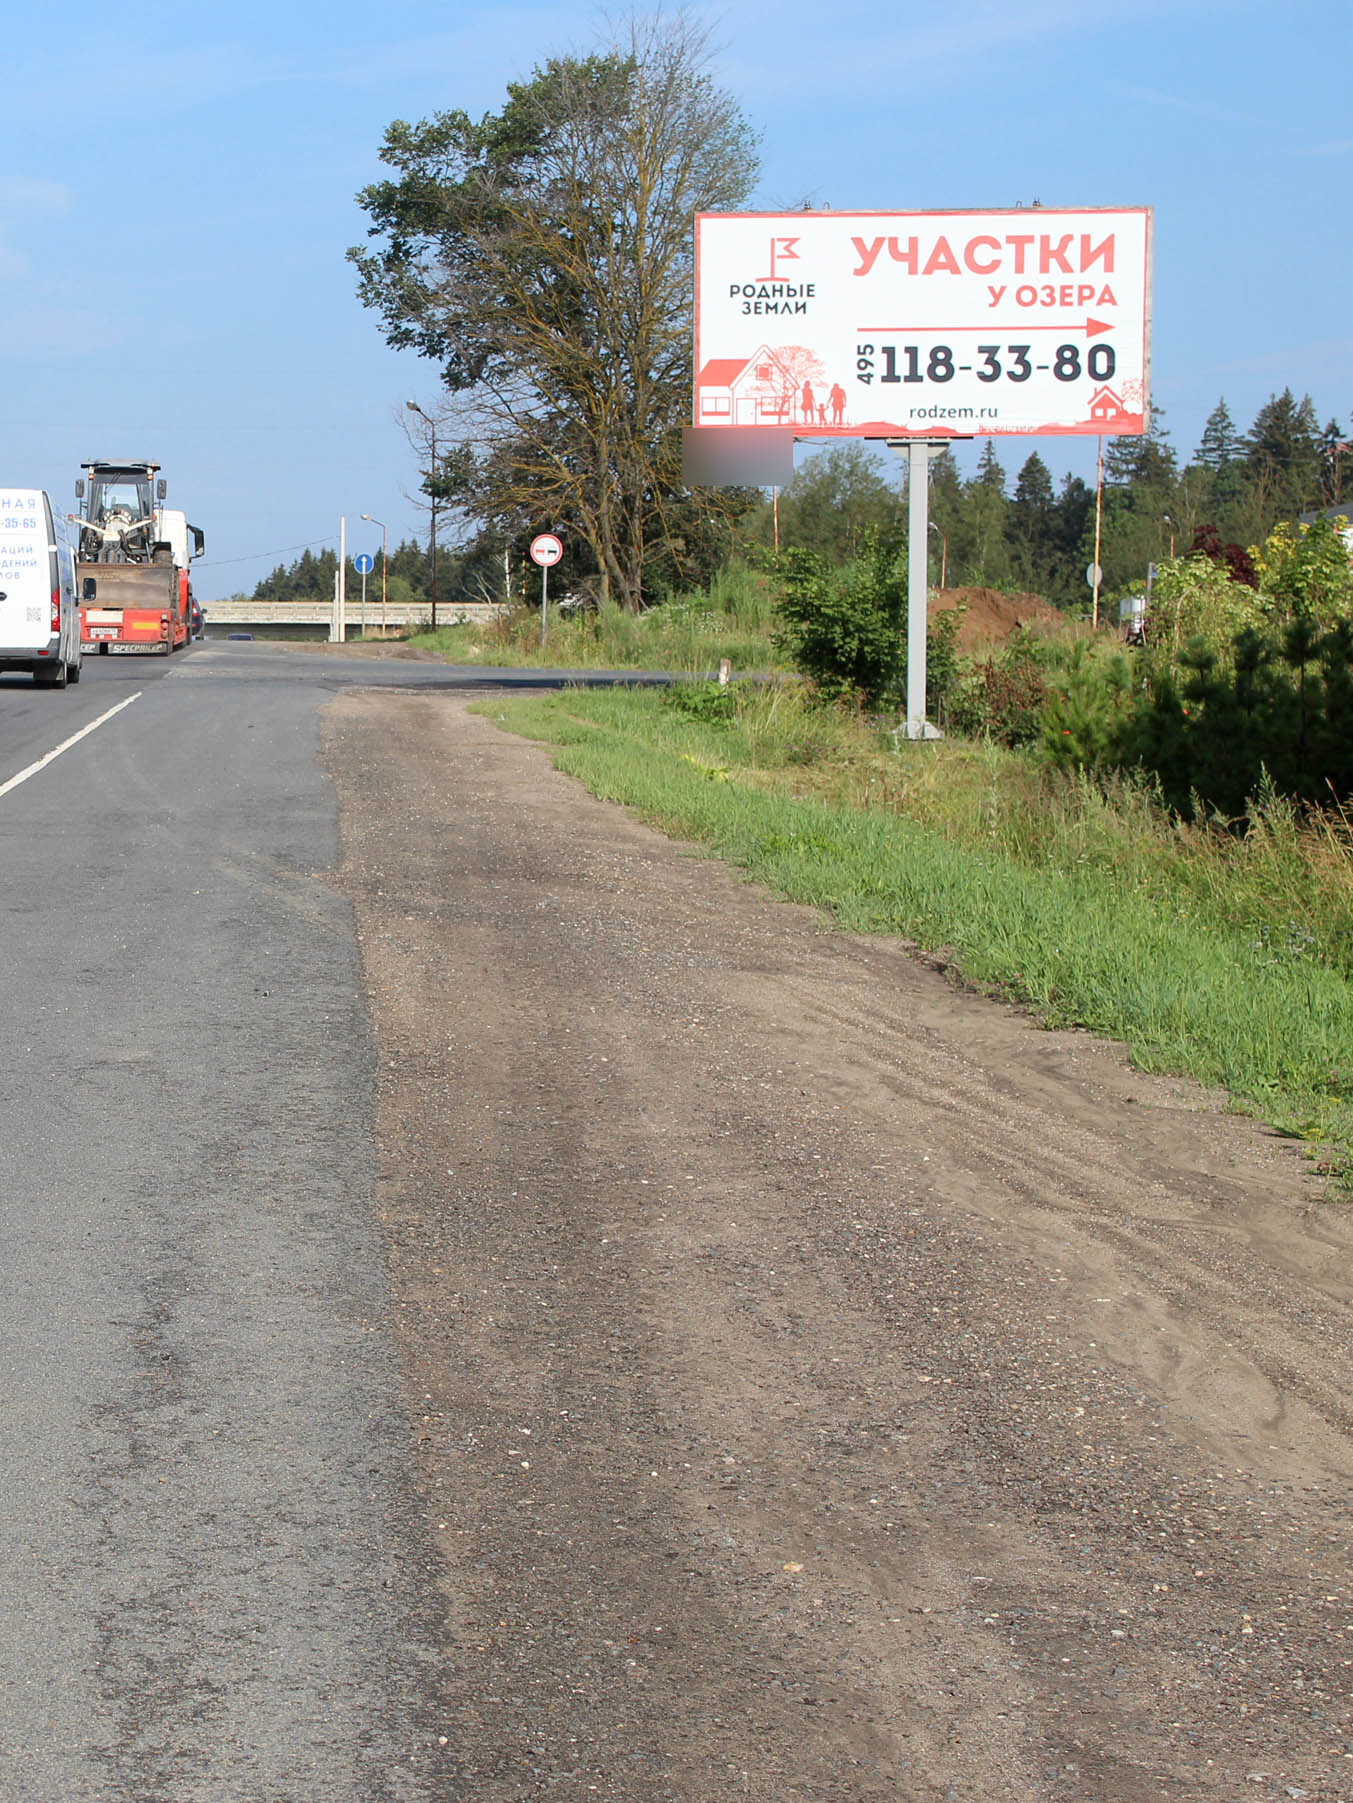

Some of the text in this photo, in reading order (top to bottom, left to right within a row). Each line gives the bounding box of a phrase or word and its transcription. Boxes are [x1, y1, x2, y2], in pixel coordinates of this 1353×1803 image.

[850, 233, 1116, 276] УЧАСТКИ
[729, 284, 816, 299] РОДНЫЕ
[987, 283, 1119, 308] У ОЗЕРА
[741, 301, 808, 315] ЗЕМЛИ
[856, 343, 1116, 386] 495 118-33-80
[909, 404, 999, 419] rodzem.ru
